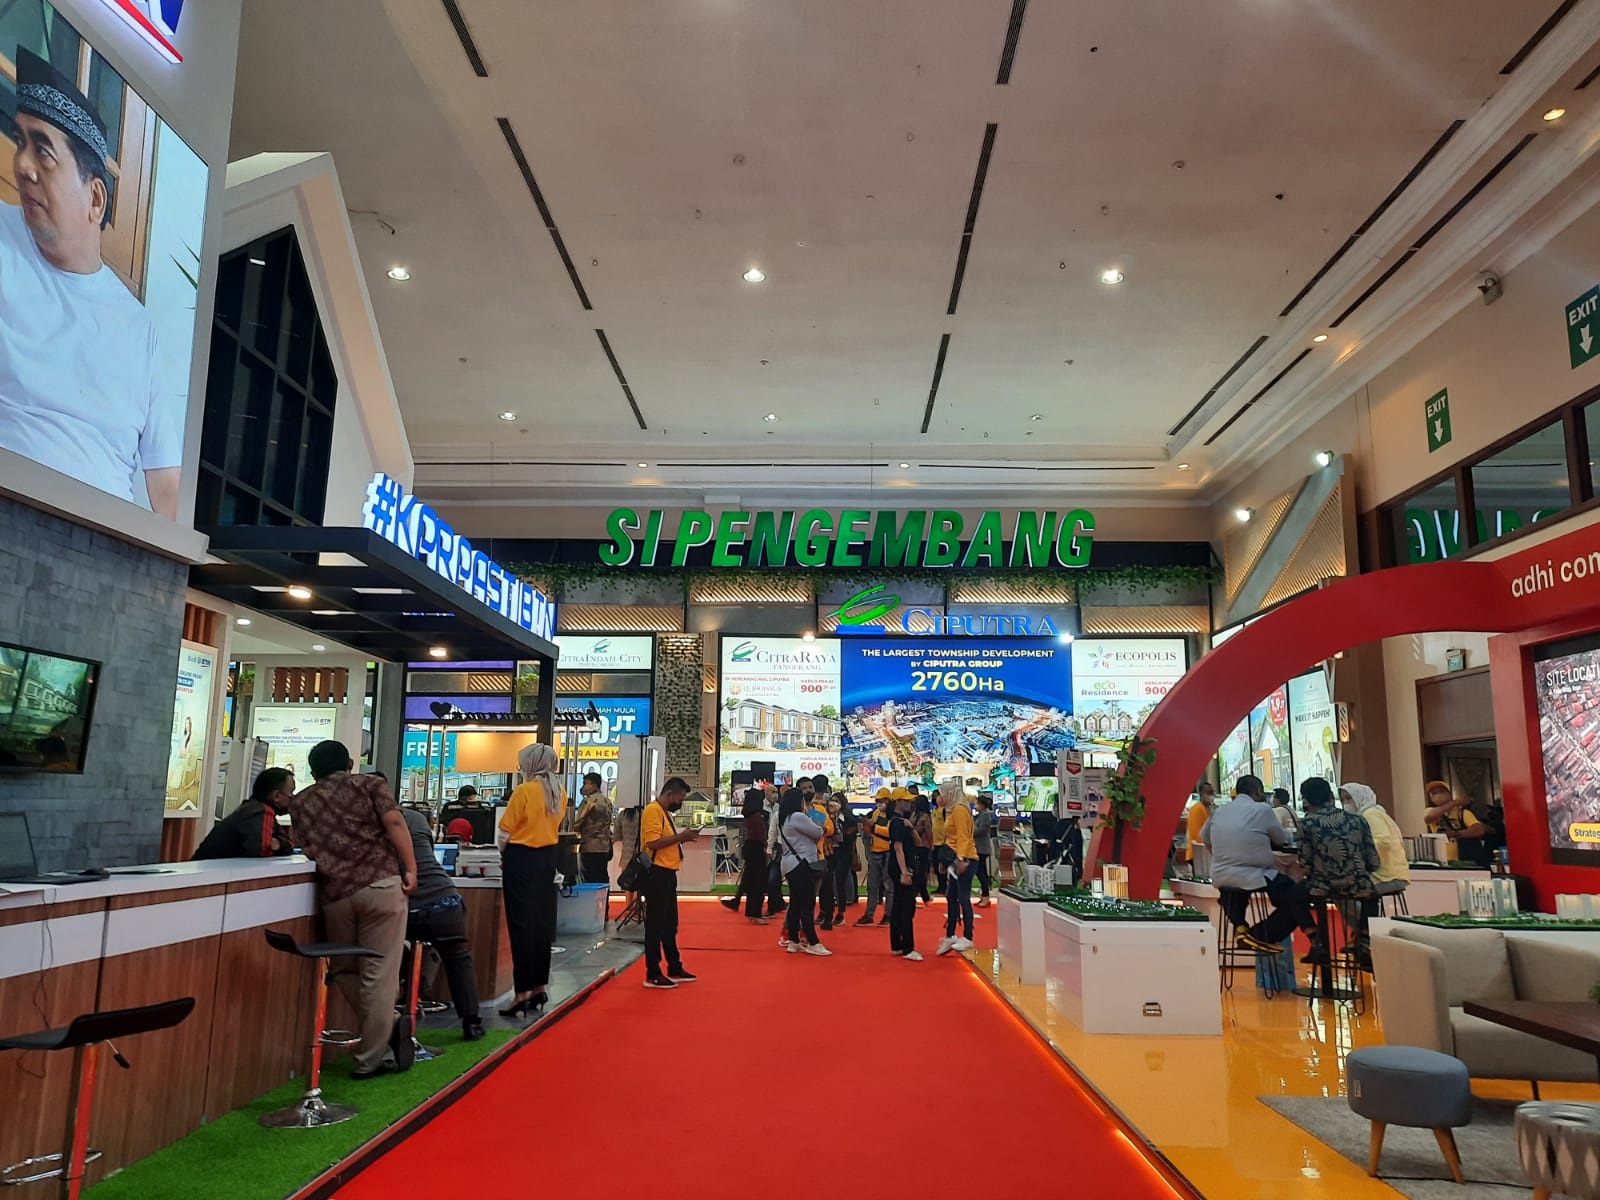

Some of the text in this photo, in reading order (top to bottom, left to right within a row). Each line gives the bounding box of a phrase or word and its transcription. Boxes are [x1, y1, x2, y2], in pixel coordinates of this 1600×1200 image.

[1568, 294, 1599, 326] EXIT
[1427, 395, 1447, 418] EXIT
[599, 506, 1096, 568] SI PENGEMBANG
[1511, 559, 1555, 598] adhi
[901, 607, 1060, 636] CIPUTRA
[862, 649, 1054, 658] THE LARGEST TOWNSHIP DEVELOPMENT
[1115, 651, 1177, 661] ECOPOLIS
[923, 660, 966, 668] CIPUTRA
[968, 660, 1003, 668] GROUP
[1546, 670, 1566, 686] SITE
[800, 684, 823, 693] 900
[1145, 686, 1167, 695] 900
[406, 741, 450, 757] FREE
[800, 762, 822, 771] 600
